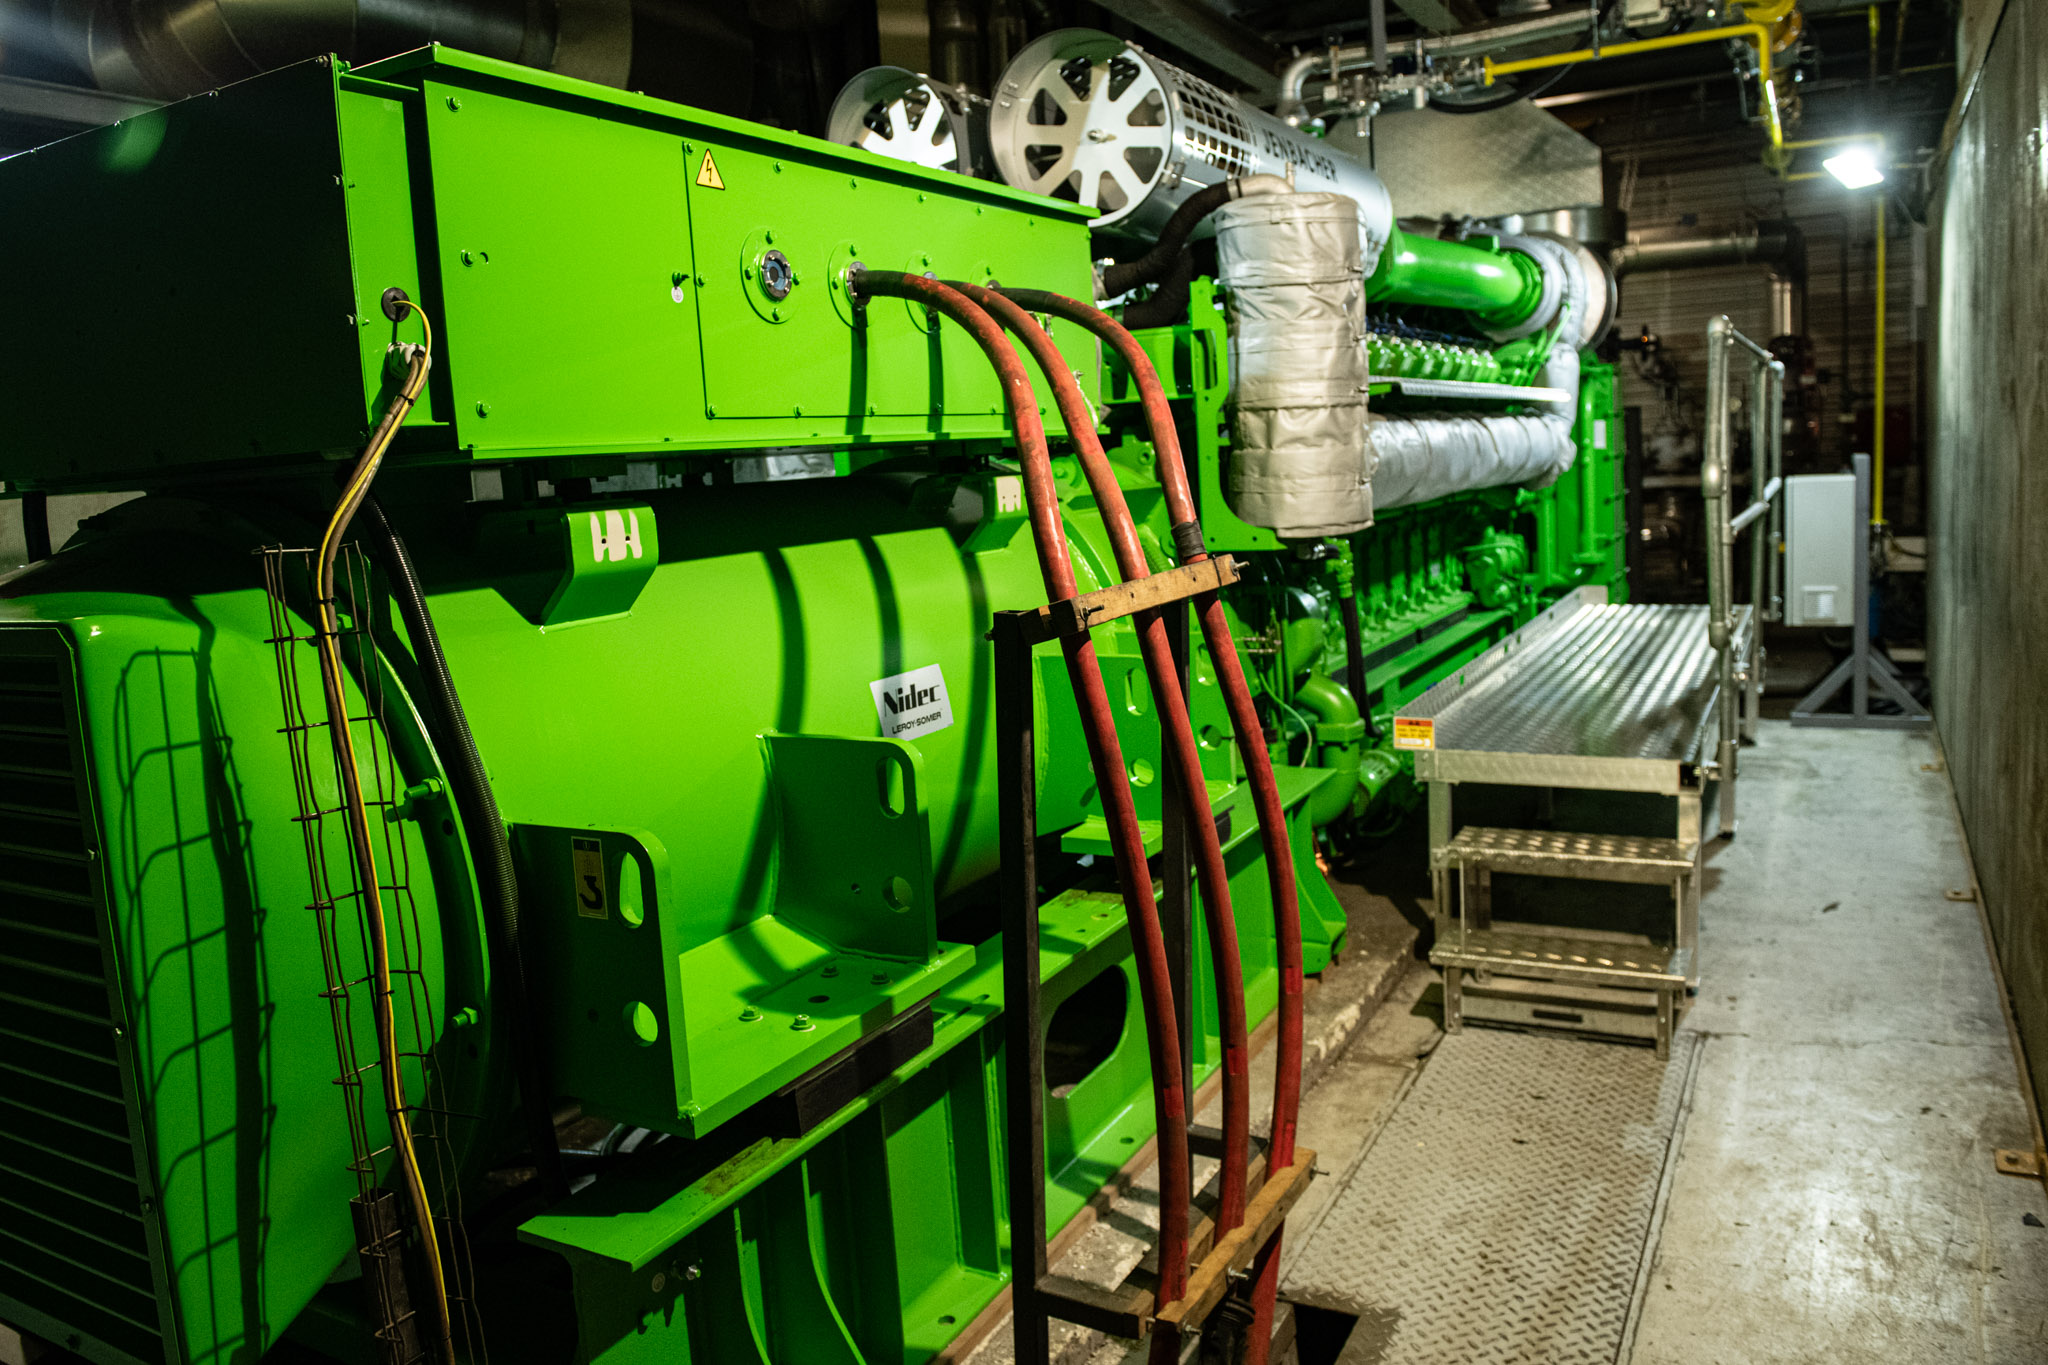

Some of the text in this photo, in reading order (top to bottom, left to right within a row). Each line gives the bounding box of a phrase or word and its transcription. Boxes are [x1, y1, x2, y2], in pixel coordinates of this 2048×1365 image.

[1262, 128, 1338, 184] JENBACHER
[883, 683, 941, 717] Nidec
[892, 711, 941, 734] LEROY-SOMER
